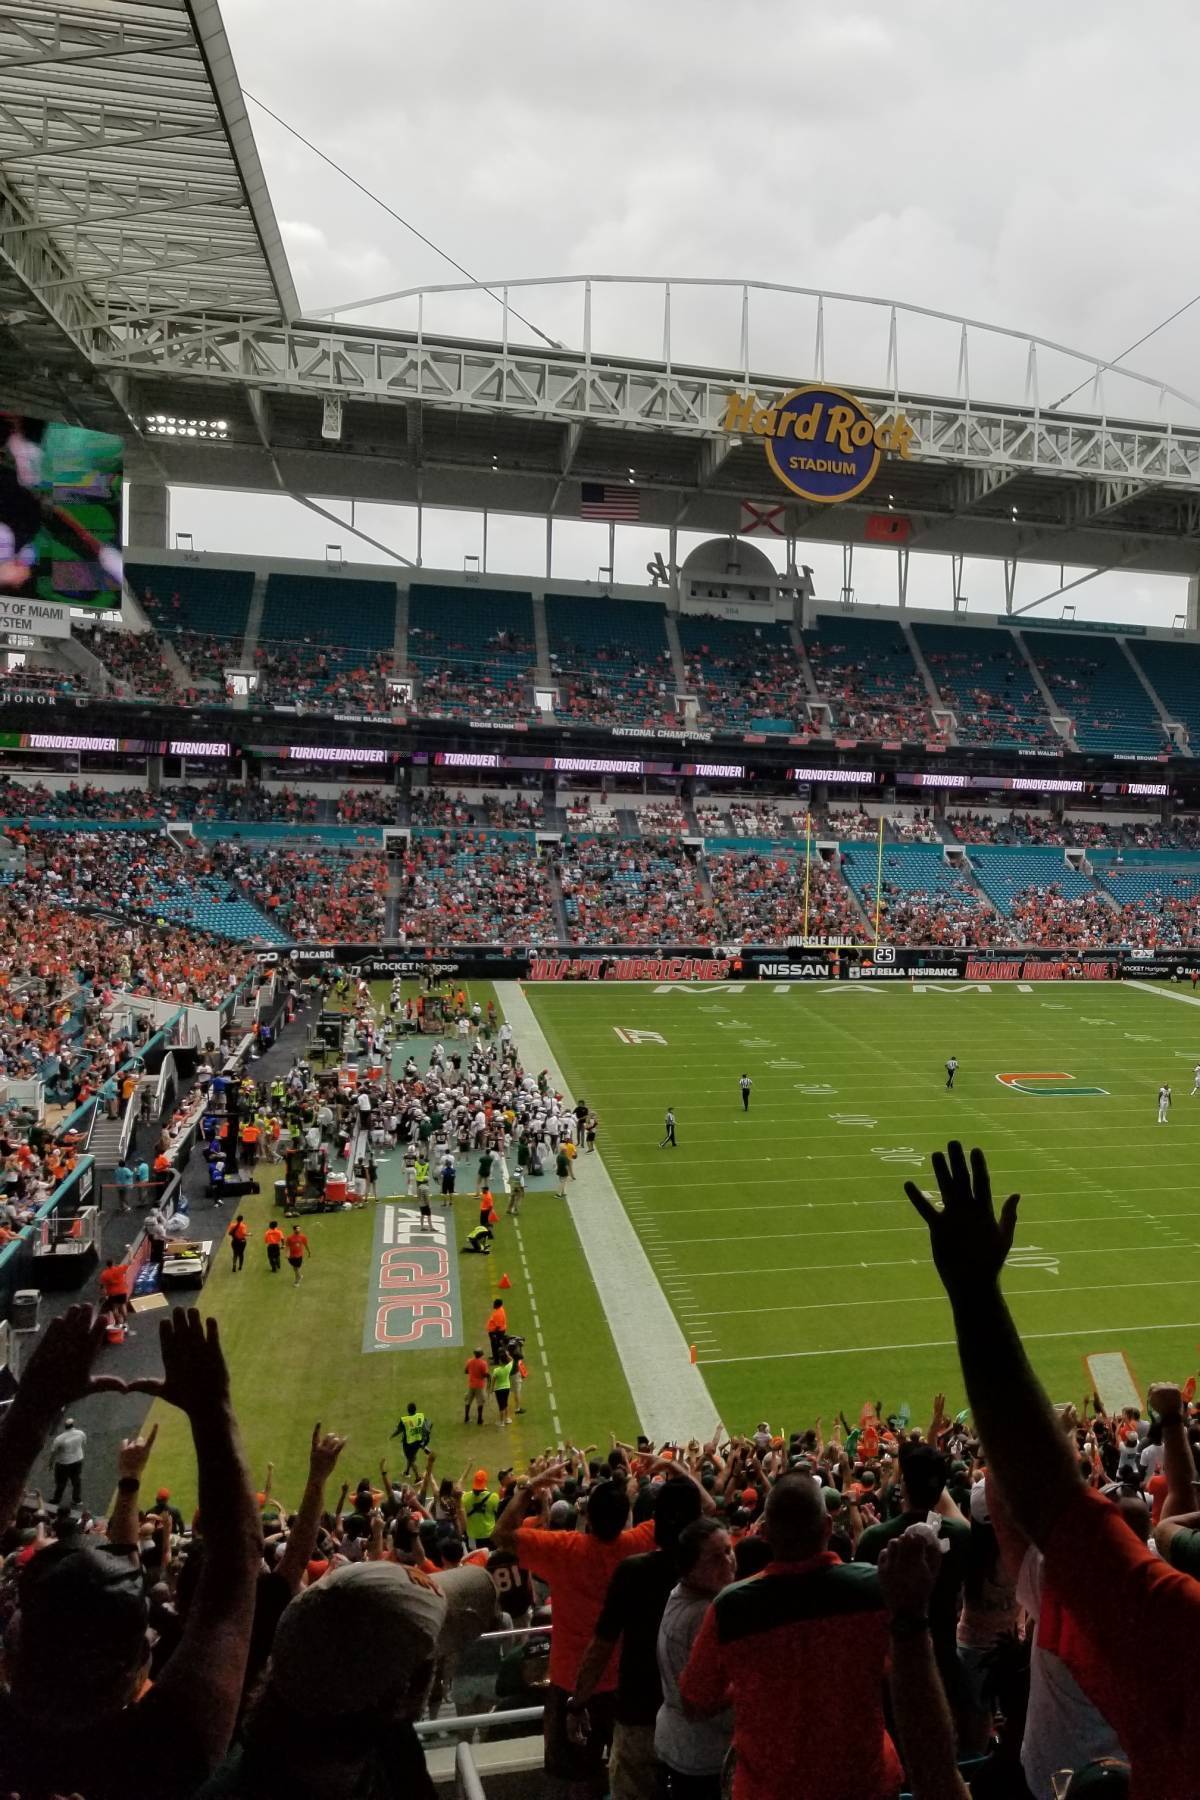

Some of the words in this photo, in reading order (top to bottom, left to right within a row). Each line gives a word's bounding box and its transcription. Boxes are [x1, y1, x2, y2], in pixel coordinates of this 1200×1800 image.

[724, 393, 823, 440] Hard
[825, 405, 913, 459] Rock
[789, 456, 856, 475] STADIUM
[12, 604, 26, 615] OF
[28, 606, 63, 620] MIAMI
[3, 693, 56, 705] HONOR
[612, 727, 655, 737] NATIONAL
[657, 729, 711, 741] CHAMPIONS
[171, 741, 227, 756] TURNOVER
[444, 753, 495, 767] TURNOVER
[695, 764, 742, 778] TURNOVER
[922, 774, 965, 787] TURNOVER
[1127, 783, 1167, 795] TURNOVER
[787, 936, 826, 946] MUSCLE
[828, 936, 852, 946] MILK
[876, 949, 892, 961] 25
[373, 962, 414, 970] ROCKET
[530, 960, 602, 980] MIAMI
[759, 964, 829, 976] NISSAN
[861, 967, 905, 977] ESTRELLA
[908, 967, 958, 977] INSURANCE
[965, 961, 1021, 979] MIAMI
[653, 984, 1034, 993] MIAMI
